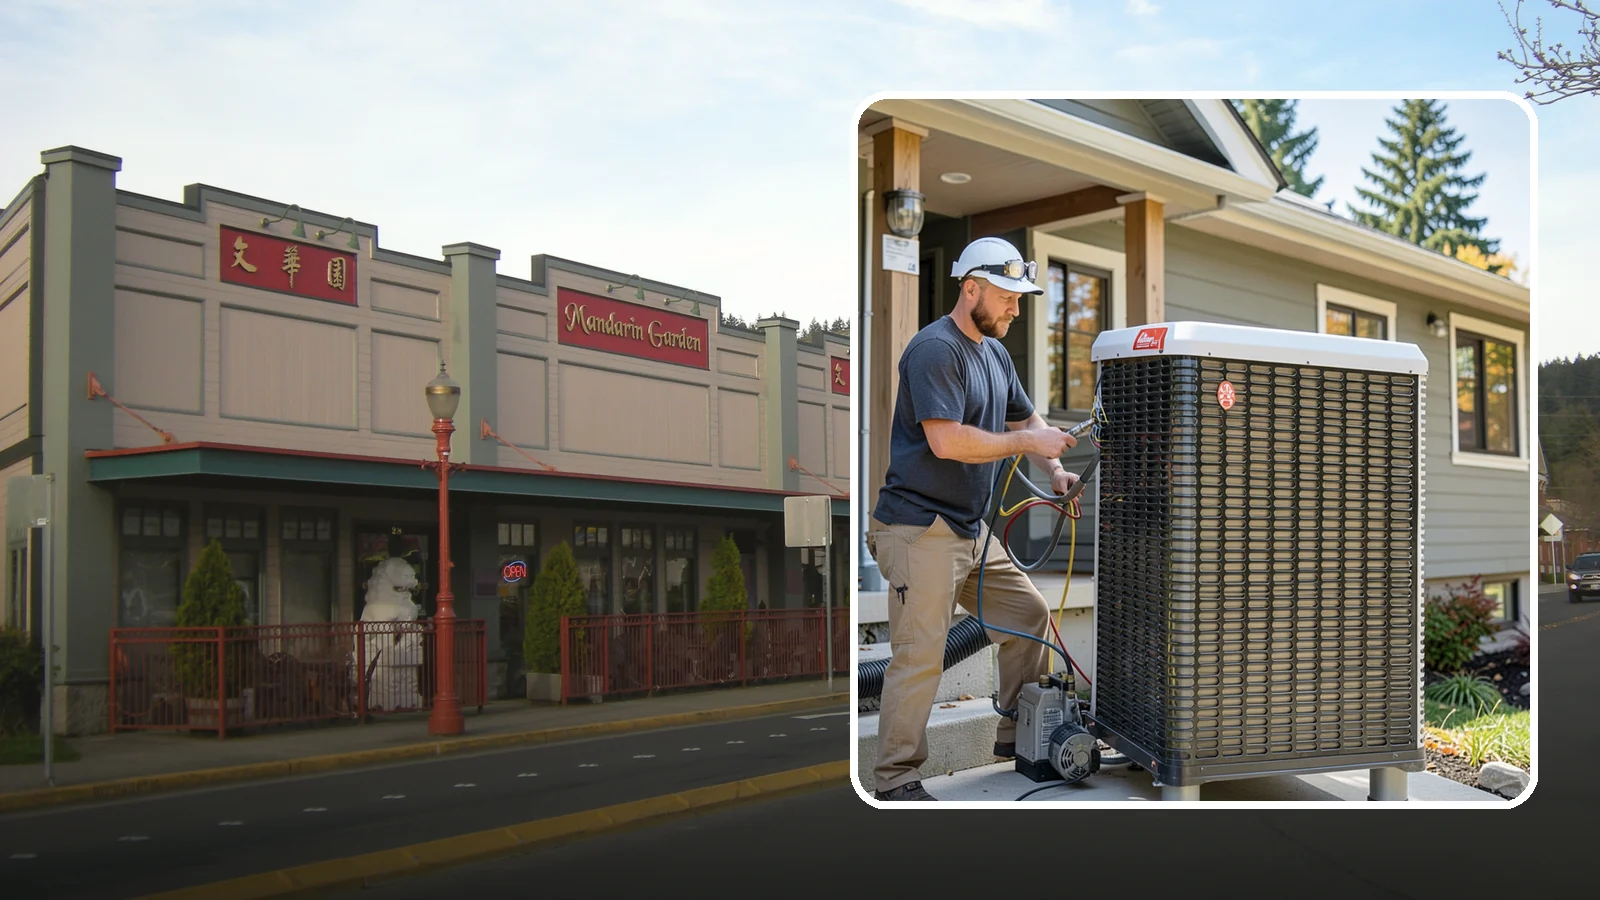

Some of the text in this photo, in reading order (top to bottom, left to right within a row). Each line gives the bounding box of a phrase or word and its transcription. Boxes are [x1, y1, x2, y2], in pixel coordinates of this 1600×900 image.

[230, 235, 346, 291] 文華園
[564, 302, 701, 352] Mandarin Garden
[503, 565, 527, 578] OPEN
